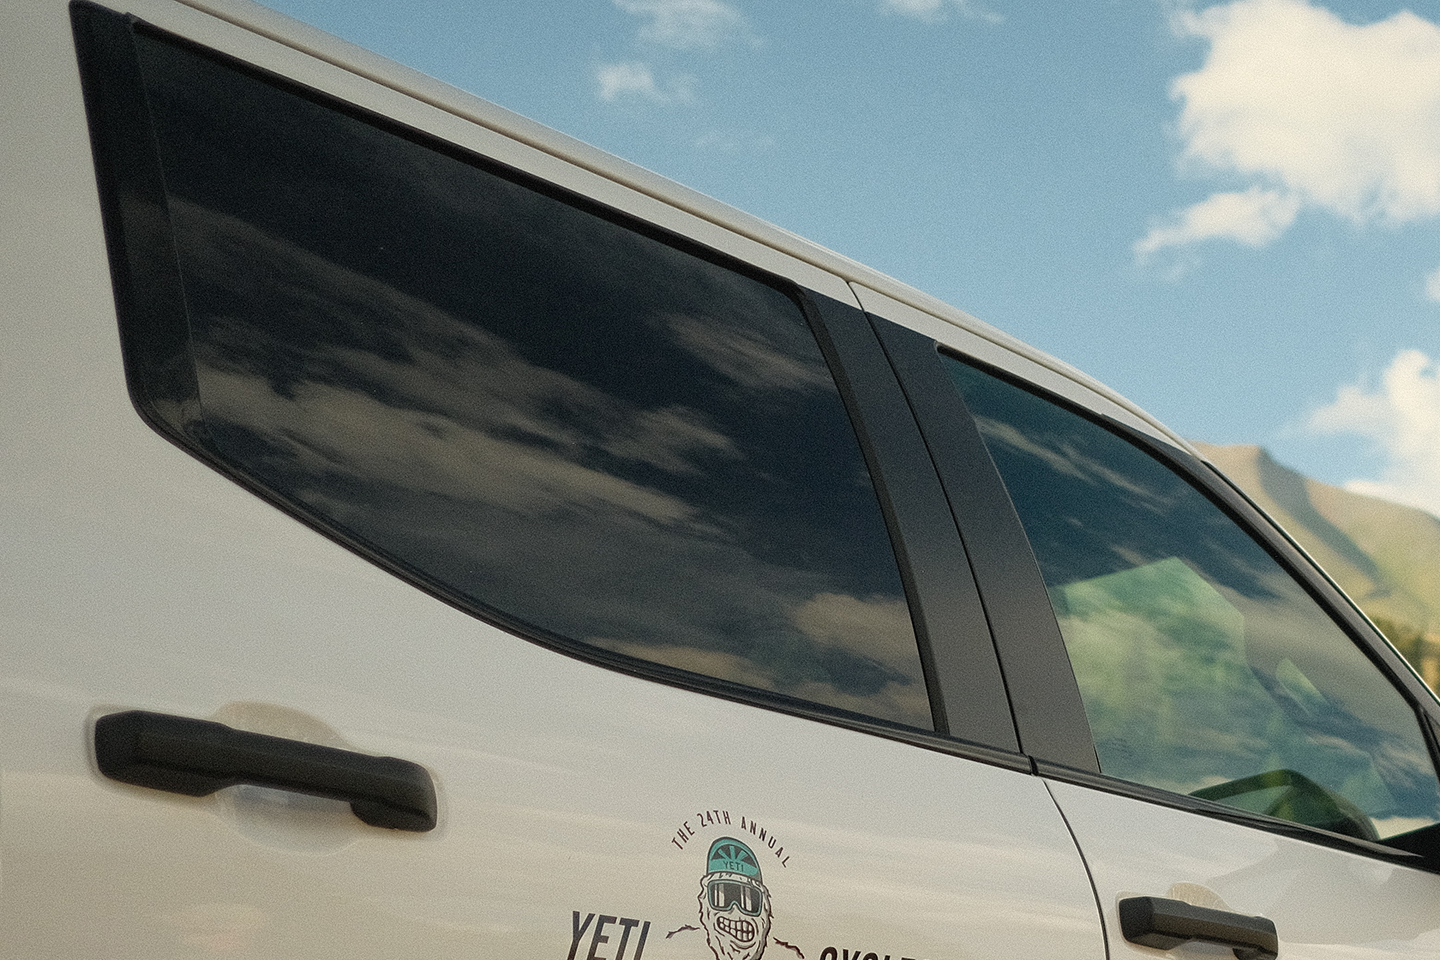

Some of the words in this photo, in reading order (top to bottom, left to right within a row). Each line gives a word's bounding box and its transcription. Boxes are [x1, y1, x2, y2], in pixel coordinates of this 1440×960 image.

[671, 821, 695, 850] THE
[696, 810, 731, 828] 24TH
[741, 816, 790, 868] ANNUAL
[723, 861, 744, 873] YETI
